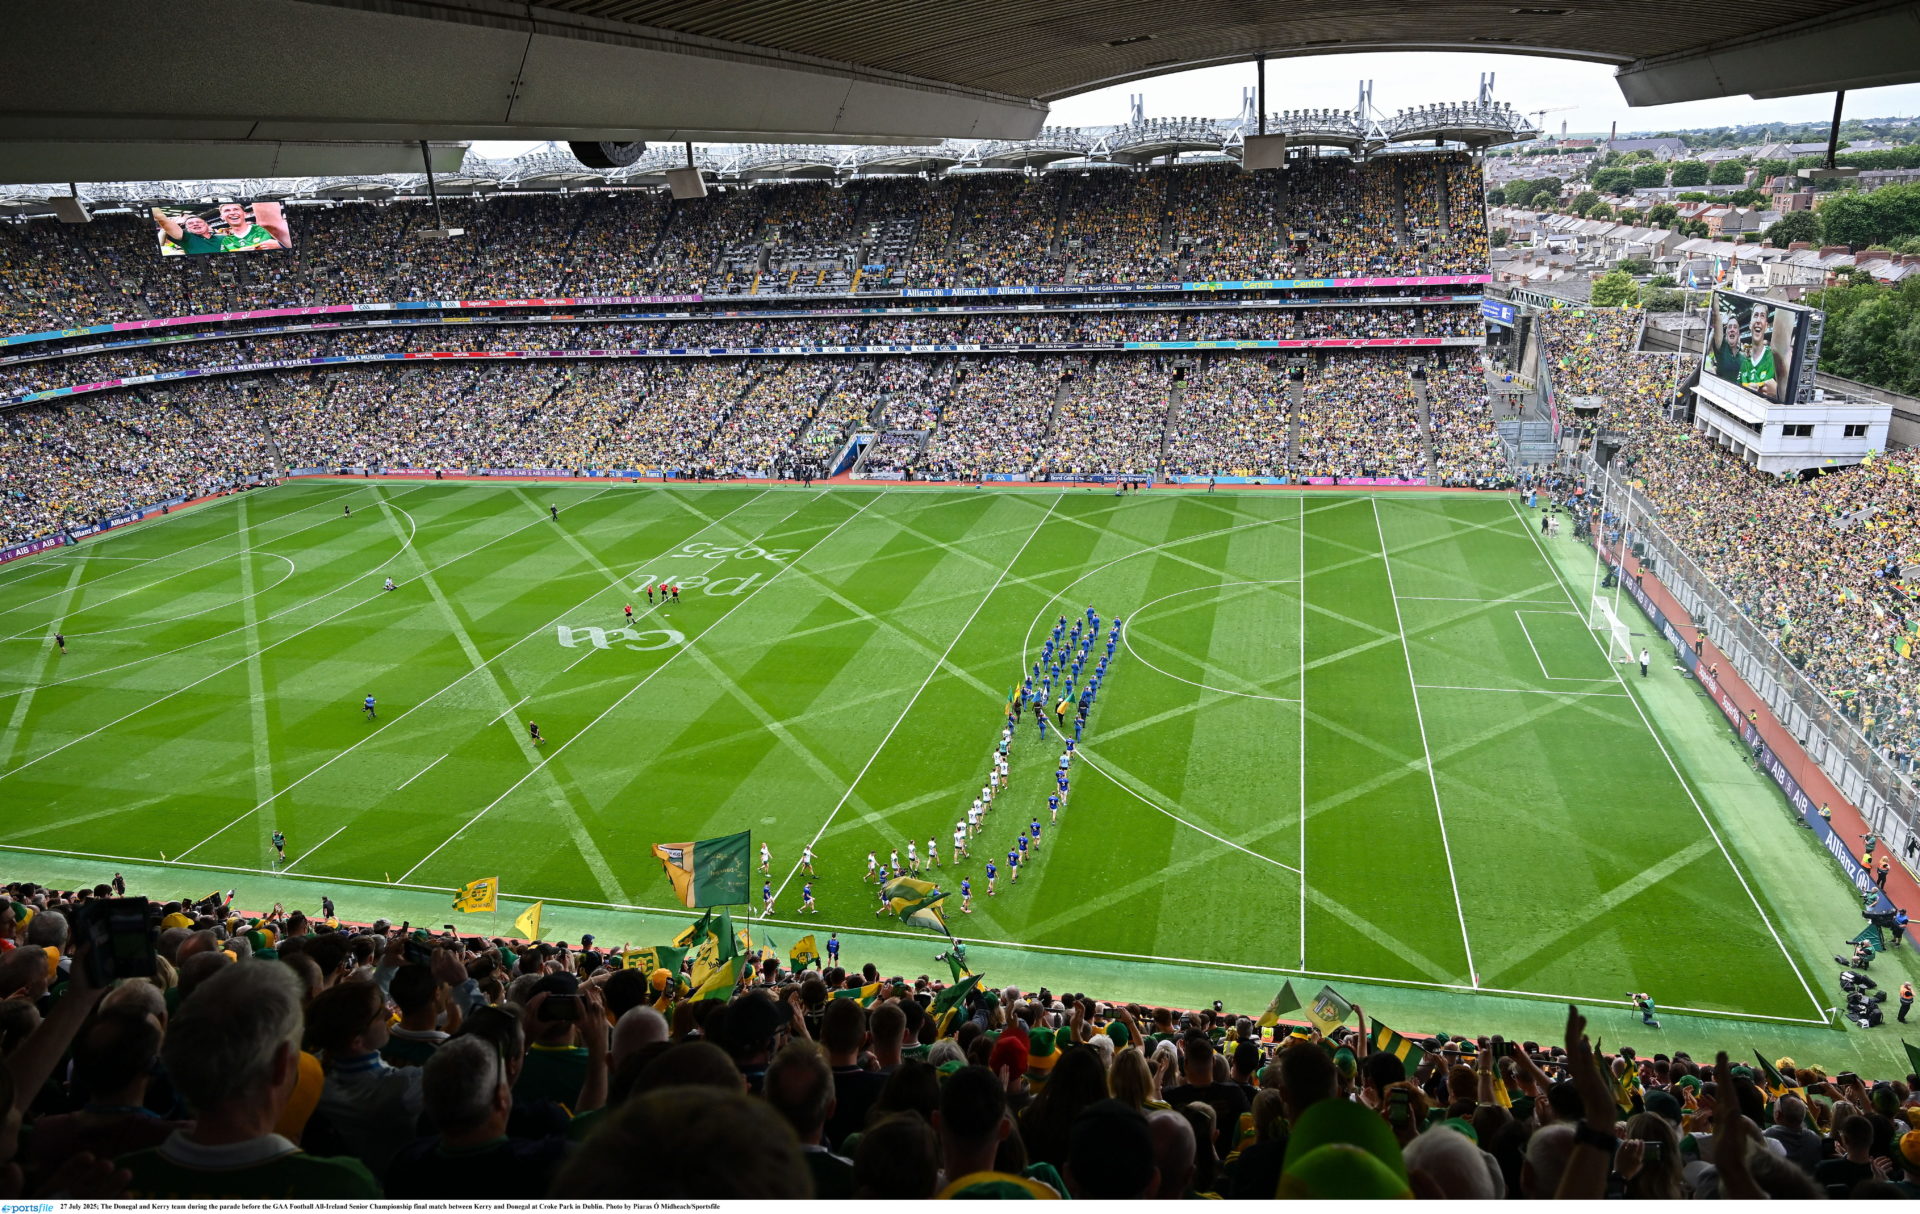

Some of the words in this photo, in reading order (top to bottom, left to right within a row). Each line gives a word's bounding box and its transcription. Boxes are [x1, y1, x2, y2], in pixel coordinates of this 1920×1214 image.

[1113, 284, 1132, 292] Energy
[1242, 280, 1273, 289] Centra
[1293, 279, 1324, 288] Centra
[906, 288, 933, 296] Allianz
[951, 287, 978, 296] Allianz
[996, 287, 1023, 295] Allianz
[601, 296, 612, 304] AIB
[199, 366, 220, 374] CROKE
[220, 365, 236, 373] PARK
[237, 361, 274, 371] MEETINGS
[110, 516, 131, 527] Allianz
[42, 538, 56, 549] AIB
[15, 546, 30, 557] AIB
[671, 541, 800, 561] 2025
[1770, 761, 1785, 785] AIB
[1792, 789, 1808, 815] AIB
[1825, 830, 1856, 880] Allianz
